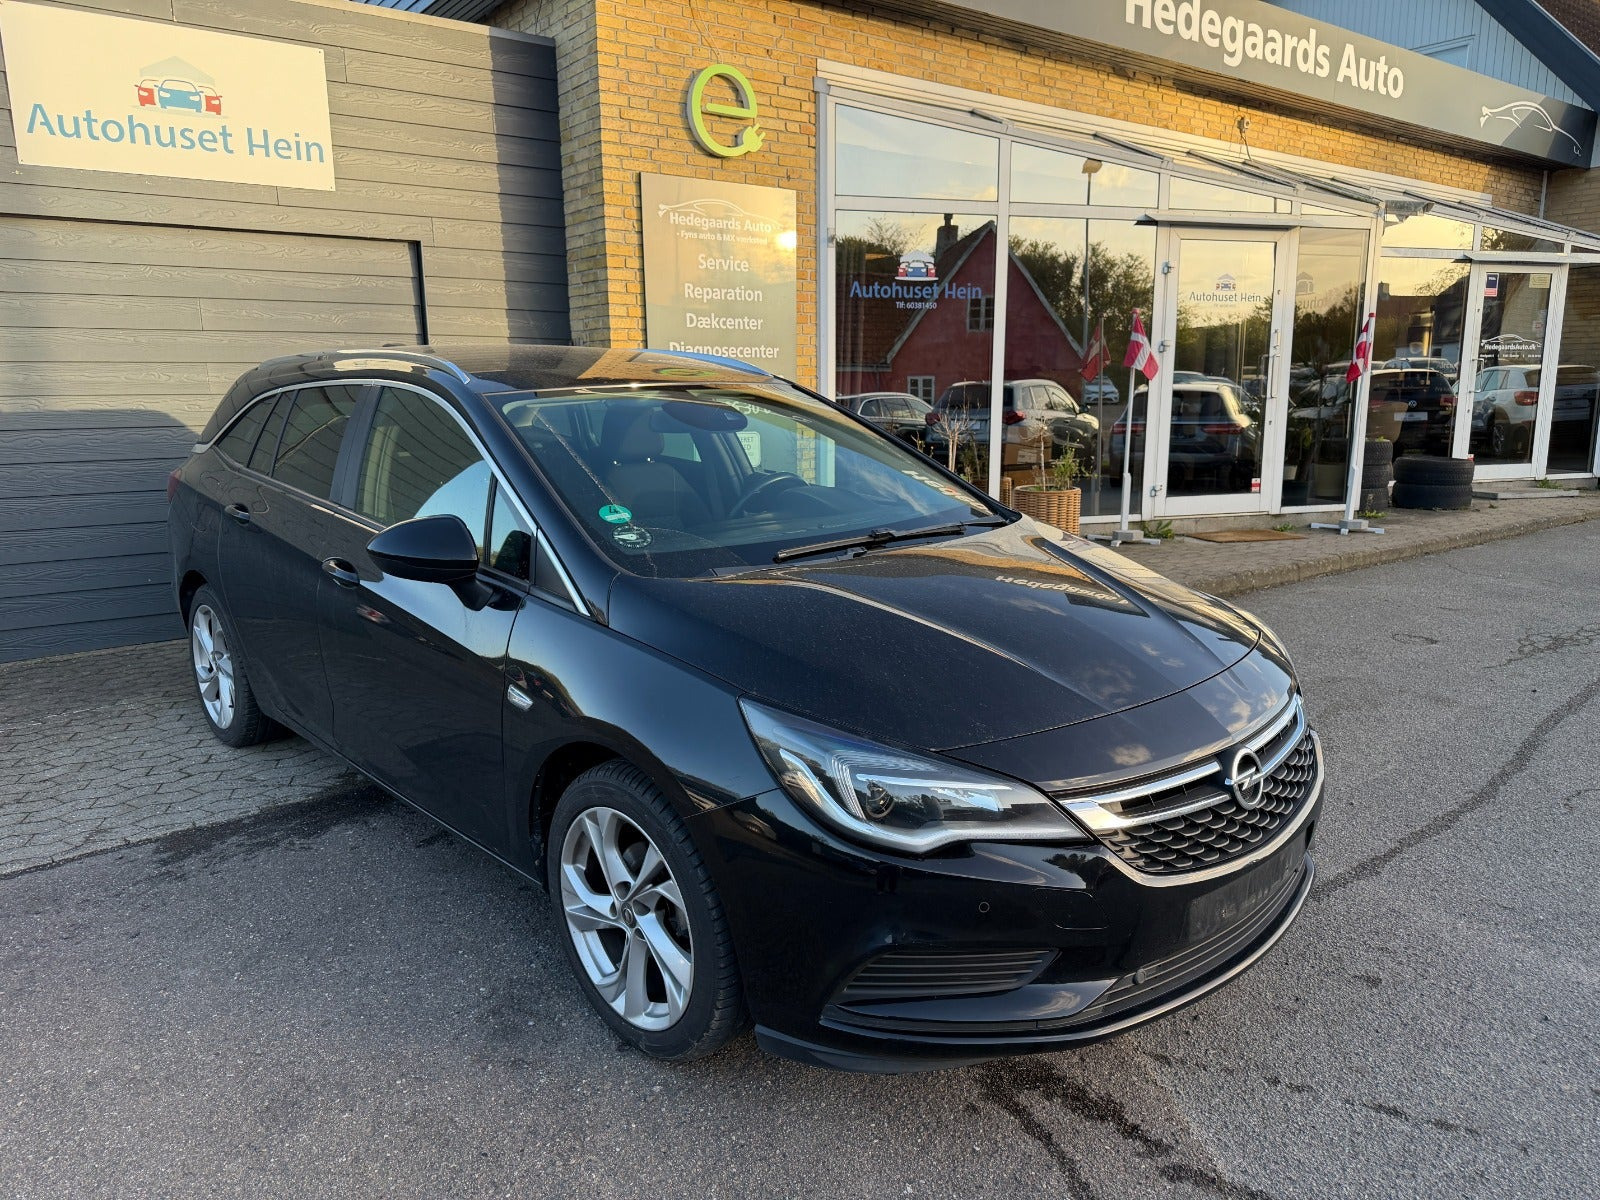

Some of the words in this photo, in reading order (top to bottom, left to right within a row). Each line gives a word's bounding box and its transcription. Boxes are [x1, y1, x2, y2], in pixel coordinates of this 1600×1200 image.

[1125, 0, 1330, 78] Hedegaards
[1337, 43, 1404, 99] Auto
[26, 103, 234, 154] Autohuset
[247, 127, 325, 163] Hein
[670, 212, 741, 230] Hedegaards
[744, 221, 772, 233] Auto
[681, 230, 698, 240] Fyns
[699, 232, 716, 241] auto
[698, 254, 749, 272] Service
[684, 283, 763, 303] Reparation
[850, 280, 939, 299] Autohuset
[945, 283, 982, 300] Hein
[1189, 291, 1238, 302] Autohuset
[1240, 292, 1261, 303] Hein
[686, 312, 763, 331] Dækcenter
